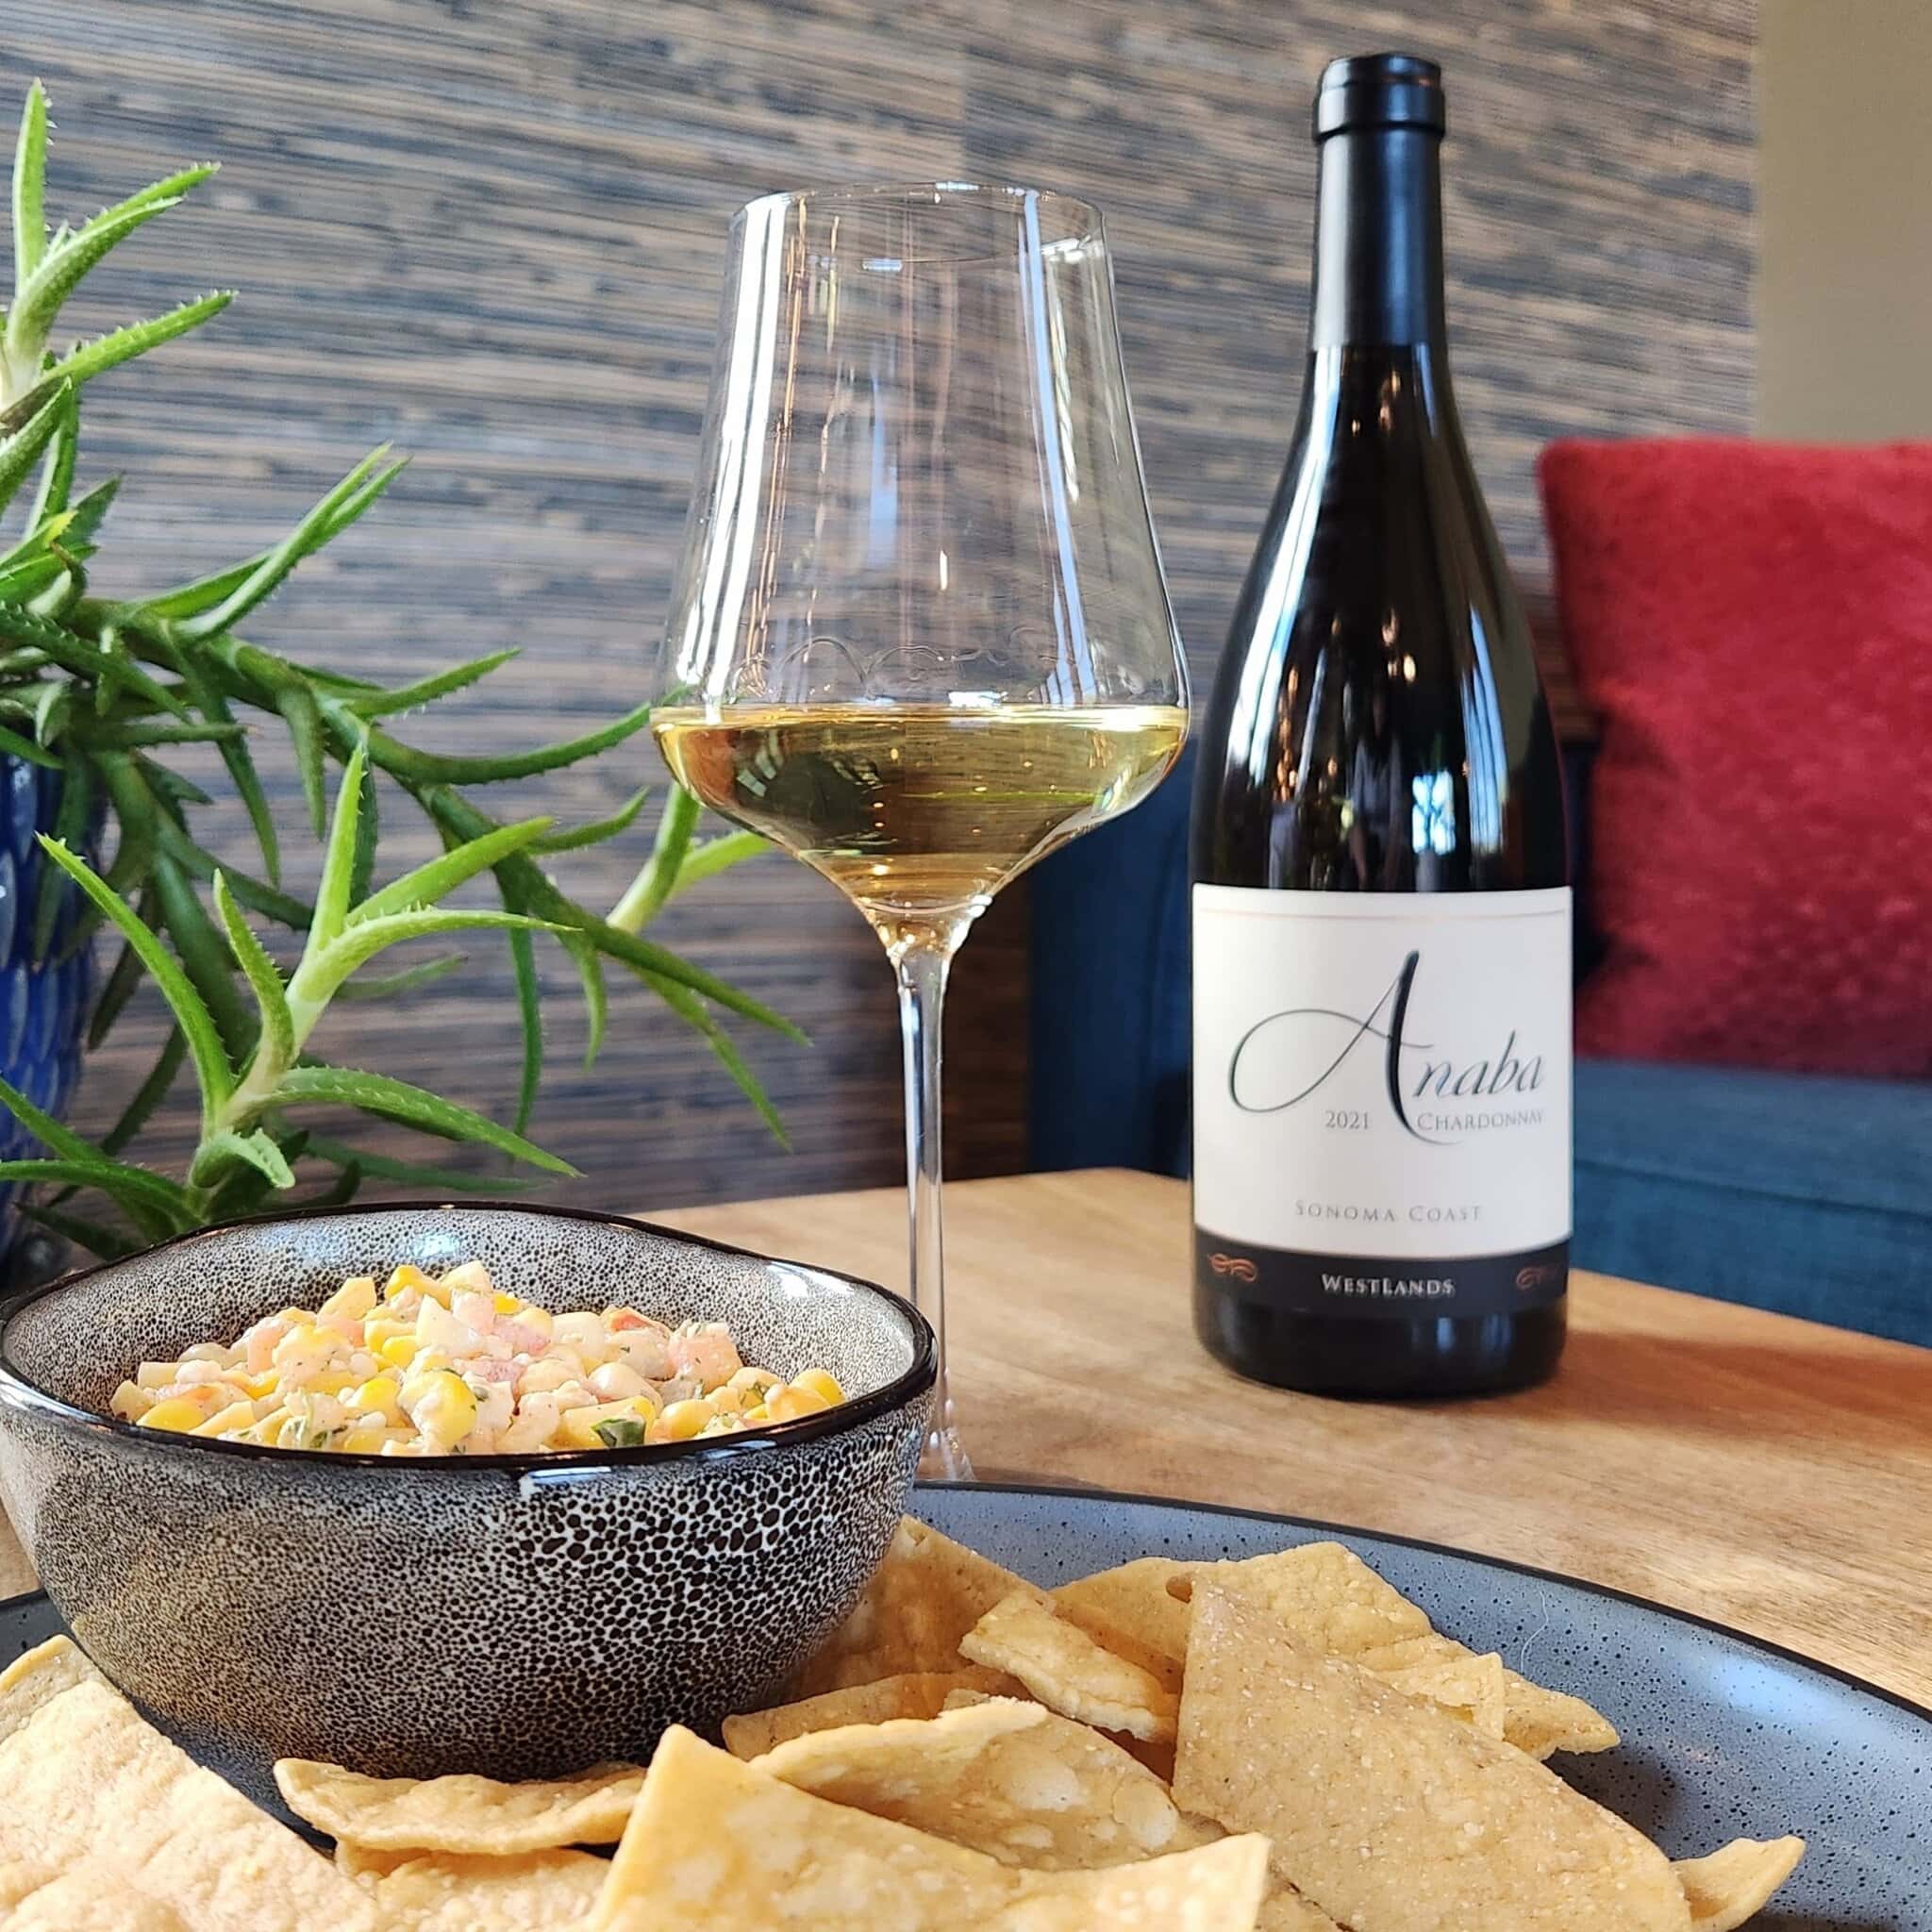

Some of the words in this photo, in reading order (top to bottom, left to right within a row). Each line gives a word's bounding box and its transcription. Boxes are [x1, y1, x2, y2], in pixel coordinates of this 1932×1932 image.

[1228, 949, 1544, 1146] Anaba
[1324, 1109, 1371, 1130] 2021
[1417, 1108, 1545, 1132] CHARDONNAY
[1294, 1199, 1395, 1223] SONOMA
[1408, 1204, 1483, 1223] COAST
[1321, 1273, 1456, 1296] WESTLANDS
